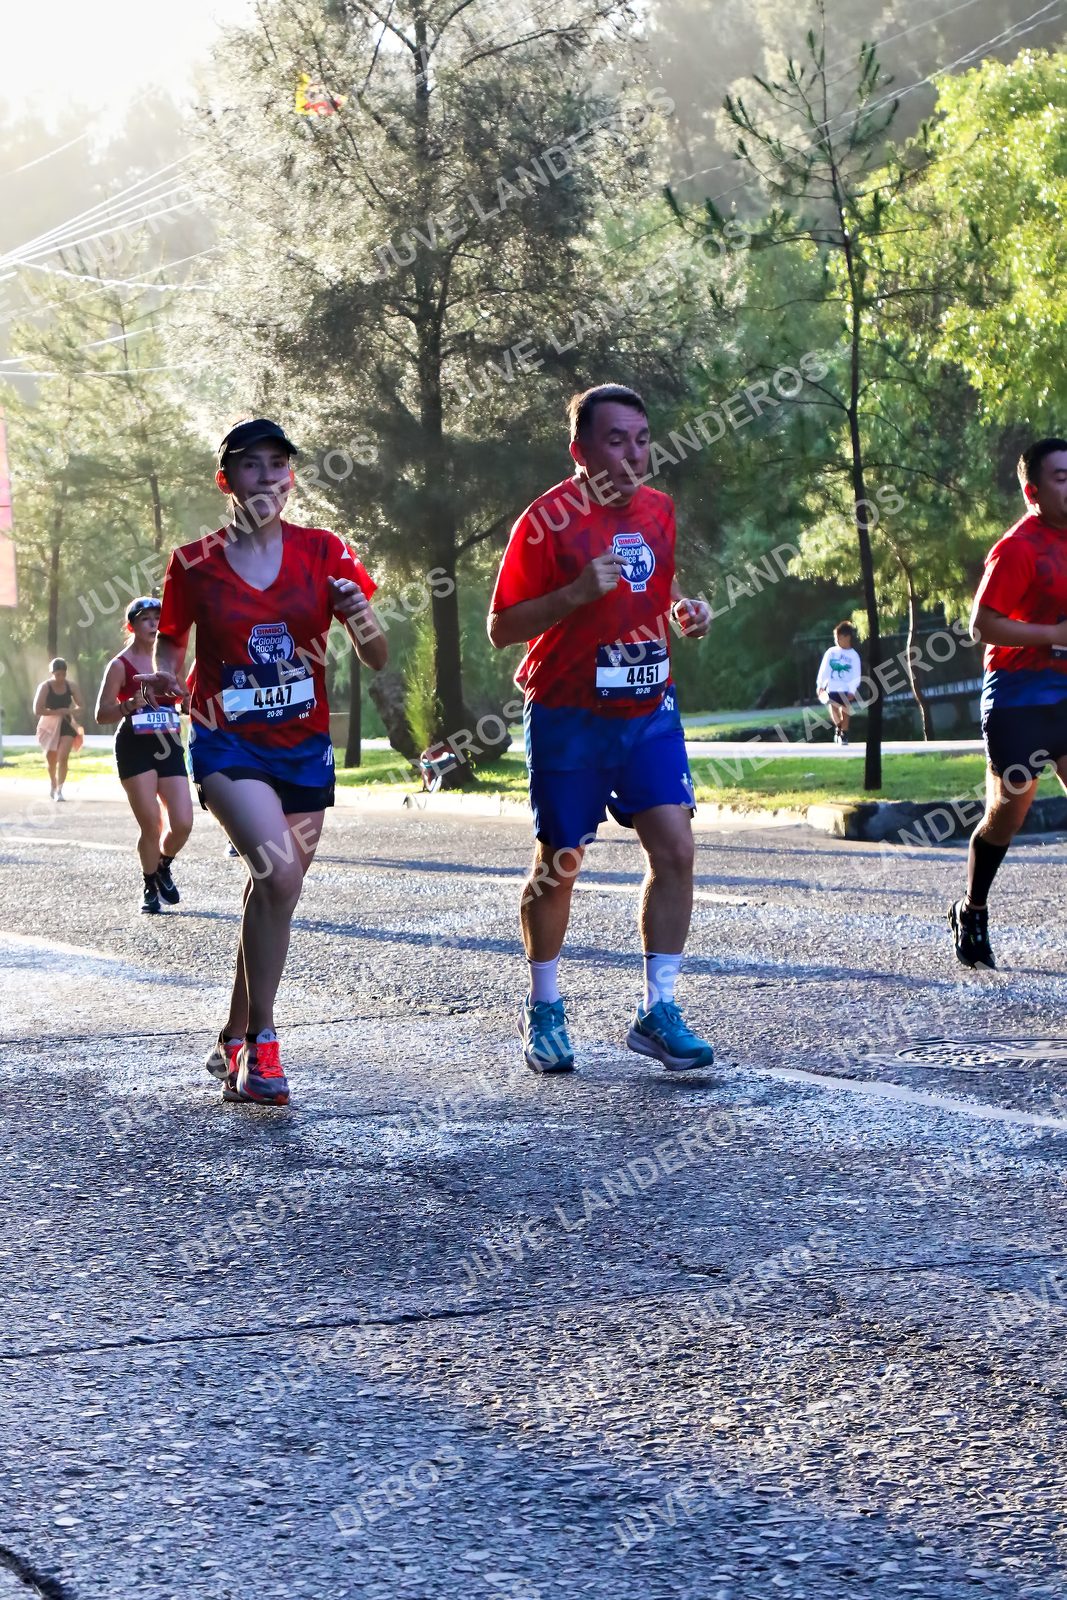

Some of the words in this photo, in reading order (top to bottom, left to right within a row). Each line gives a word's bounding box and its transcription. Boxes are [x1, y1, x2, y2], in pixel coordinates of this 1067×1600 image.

[621, 547, 642, 557] Global
[257, 627, 282, 635] BIMBO
[258, 636, 283, 646] Global
[256, 645, 274, 653] Race
[626, 664, 659, 685] 4451
[253, 685, 292, 708] 4447
[146, 713, 167, 723] 4790
[298, 711, 310, 720] 10K
